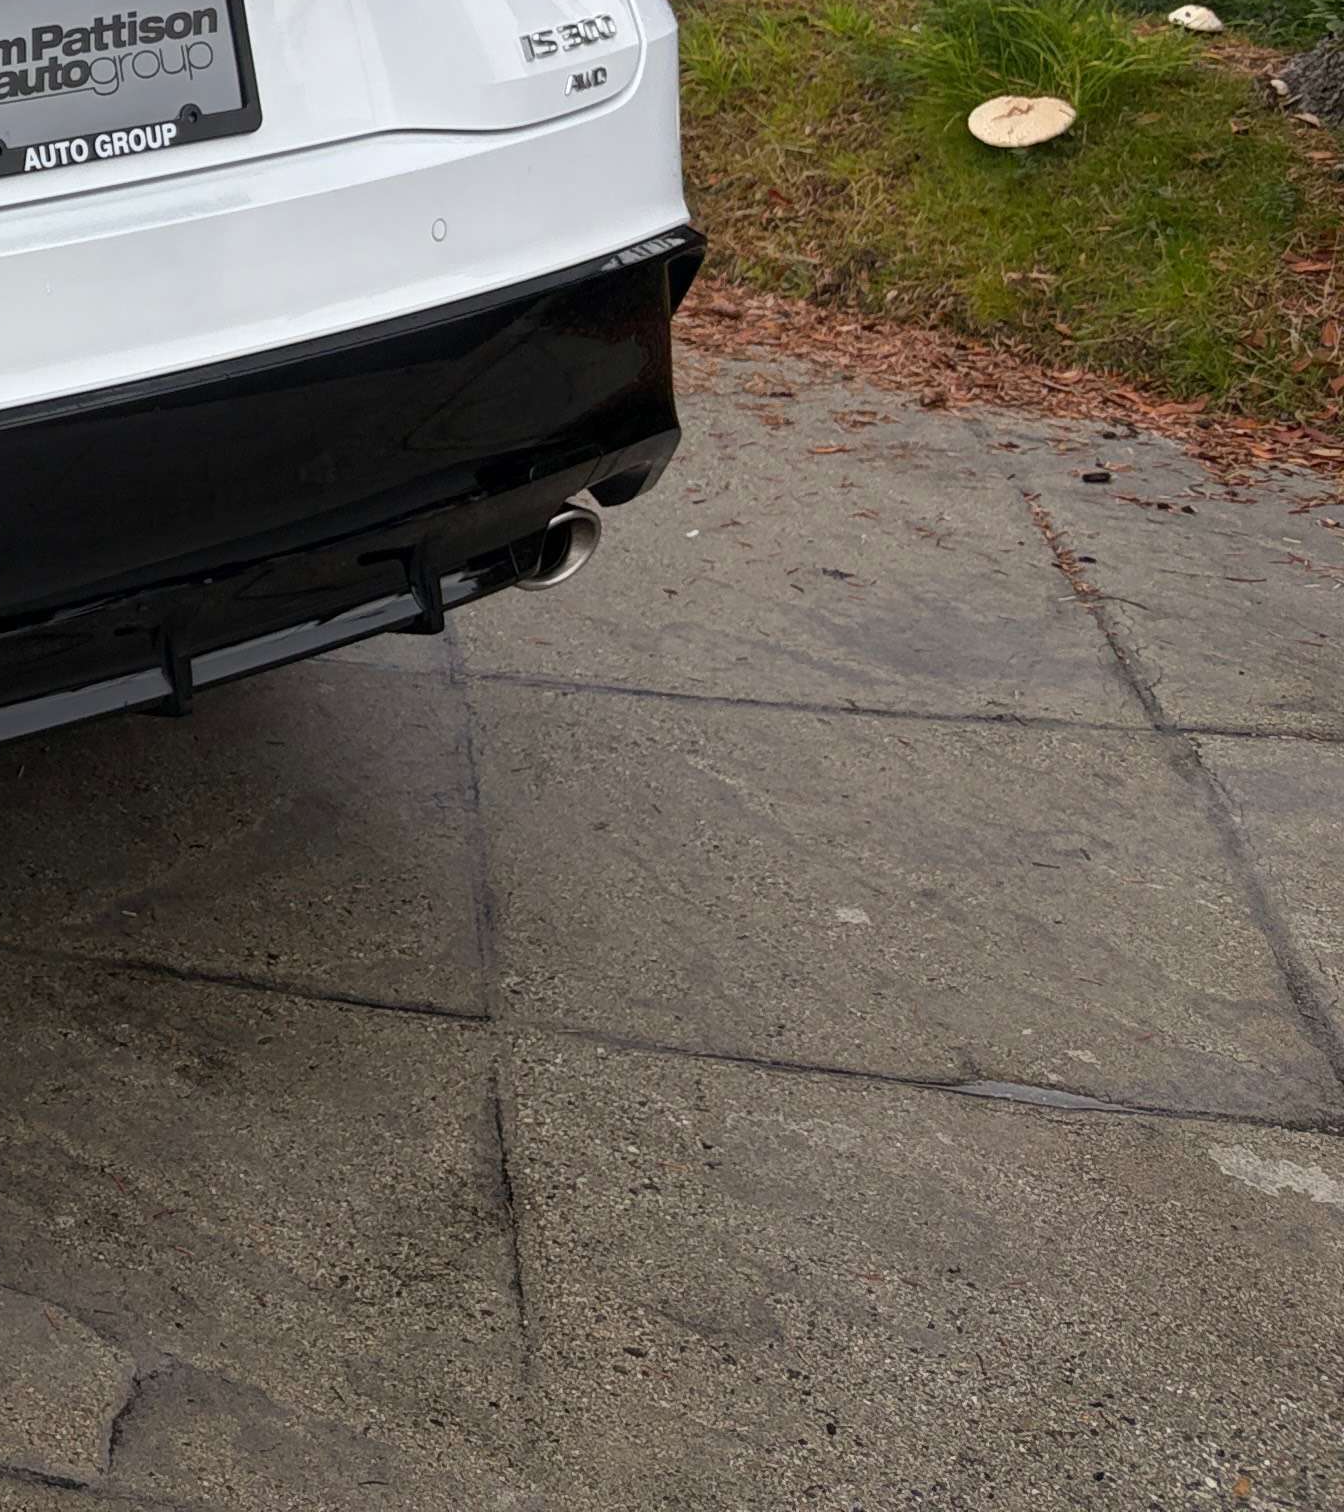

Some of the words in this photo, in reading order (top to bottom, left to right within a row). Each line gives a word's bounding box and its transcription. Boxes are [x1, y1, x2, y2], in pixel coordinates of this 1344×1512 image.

[32, 7, 218, 61] Pattison
[519, 29, 558, 63] IS
[564, 66, 608, 96] AWD
[23, 138, 89, 172] AUTO
[94, 122, 177, 159] GROUP
